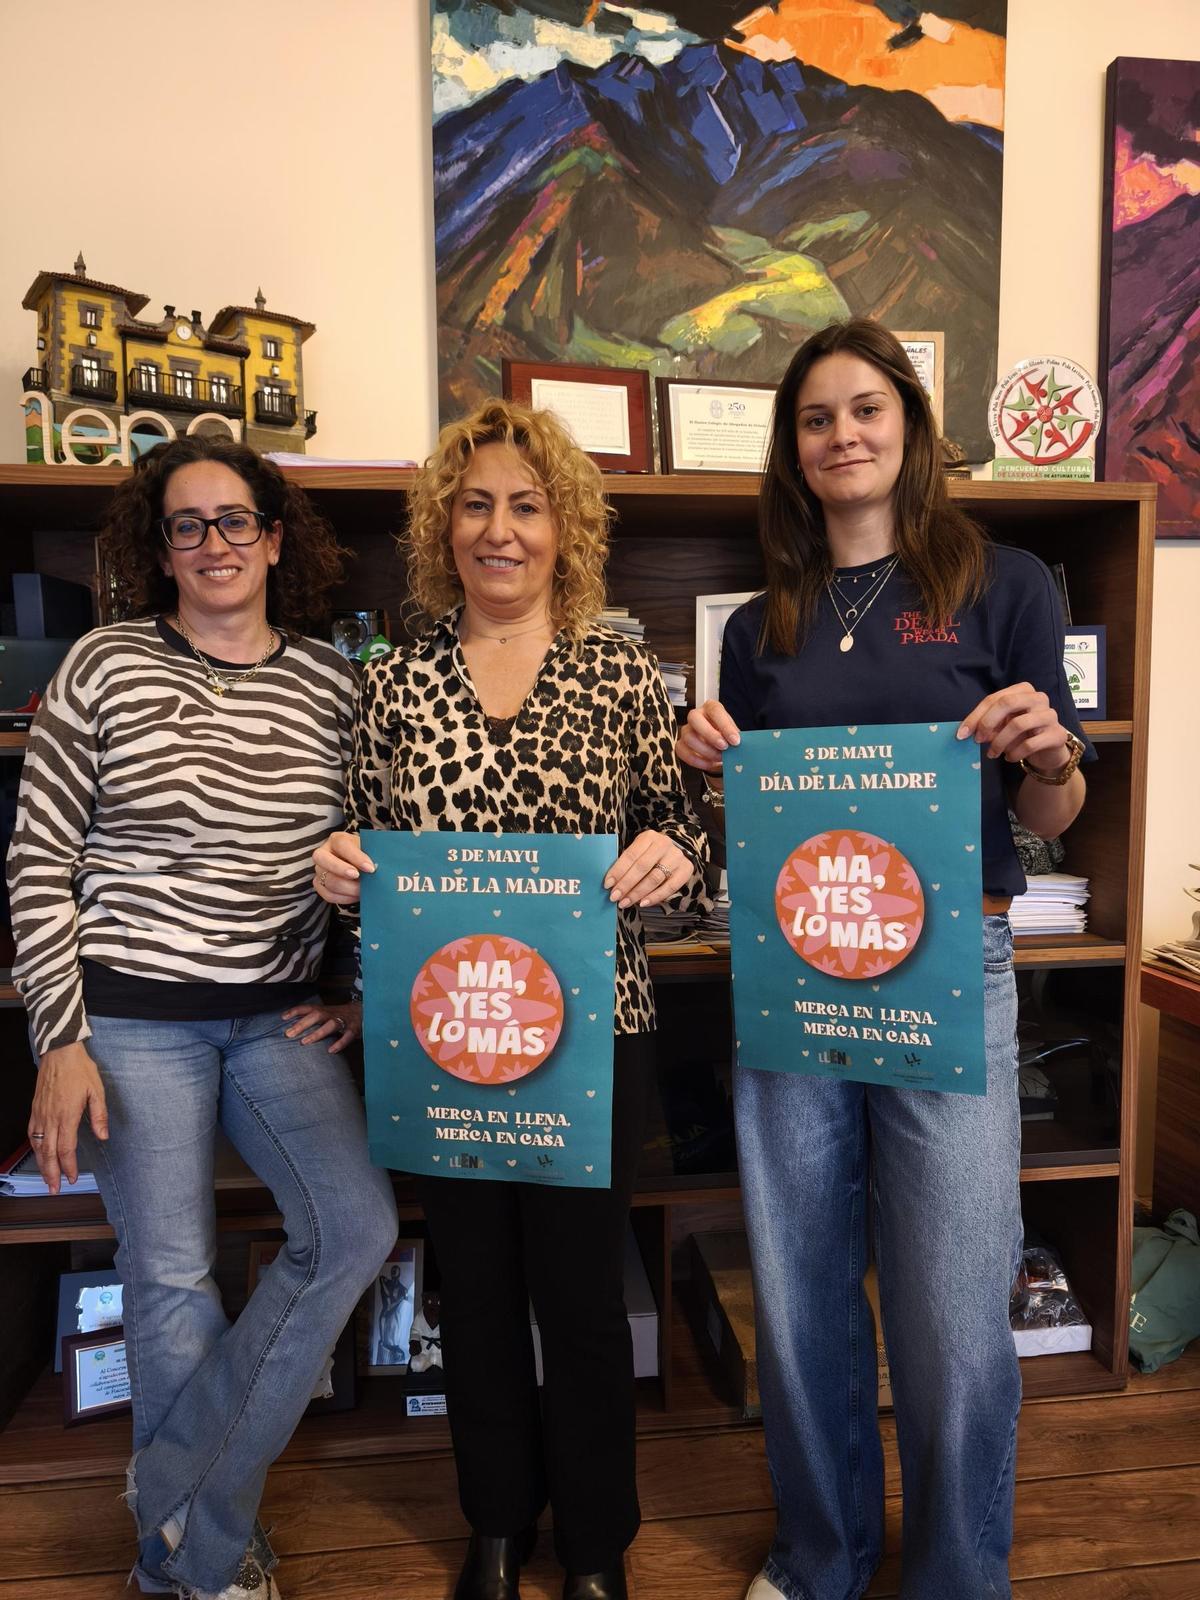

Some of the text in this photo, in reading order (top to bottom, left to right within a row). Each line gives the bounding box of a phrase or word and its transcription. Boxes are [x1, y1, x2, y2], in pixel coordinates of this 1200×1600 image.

[1051, 465, 1091, 473] CULTURAL
[901, 632, 960, 645] PRADA
[804, 745, 893, 760] 3 DE MAYU
[759, 771, 938, 791] DÍA DE LA MADRE
[447, 849, 539, 863] 3 DE MAYU
[818, 855, 886, 890] MA,
[397, 872, 581, 895] DÍA DE LA MADRE
[809, 885, 873, 915] YES
[830, 913, 907, 952] MÁS
[457, 959, 527, 996] MA,
[447, 991, 513, 1020] YES
[794, 1001, 849, 1017] MERCA
[853, 1006, 873, 1019] EN
[467, 1019, 546, 1056] MÁS
[803, 1022, 933, 1047] MERCA EN CASA
[426, 1106, 484, 1123] MERCA
[487, 1110, 508, 1124] EN
[435, 1127, 566, 1147] MERCA EN CASA
